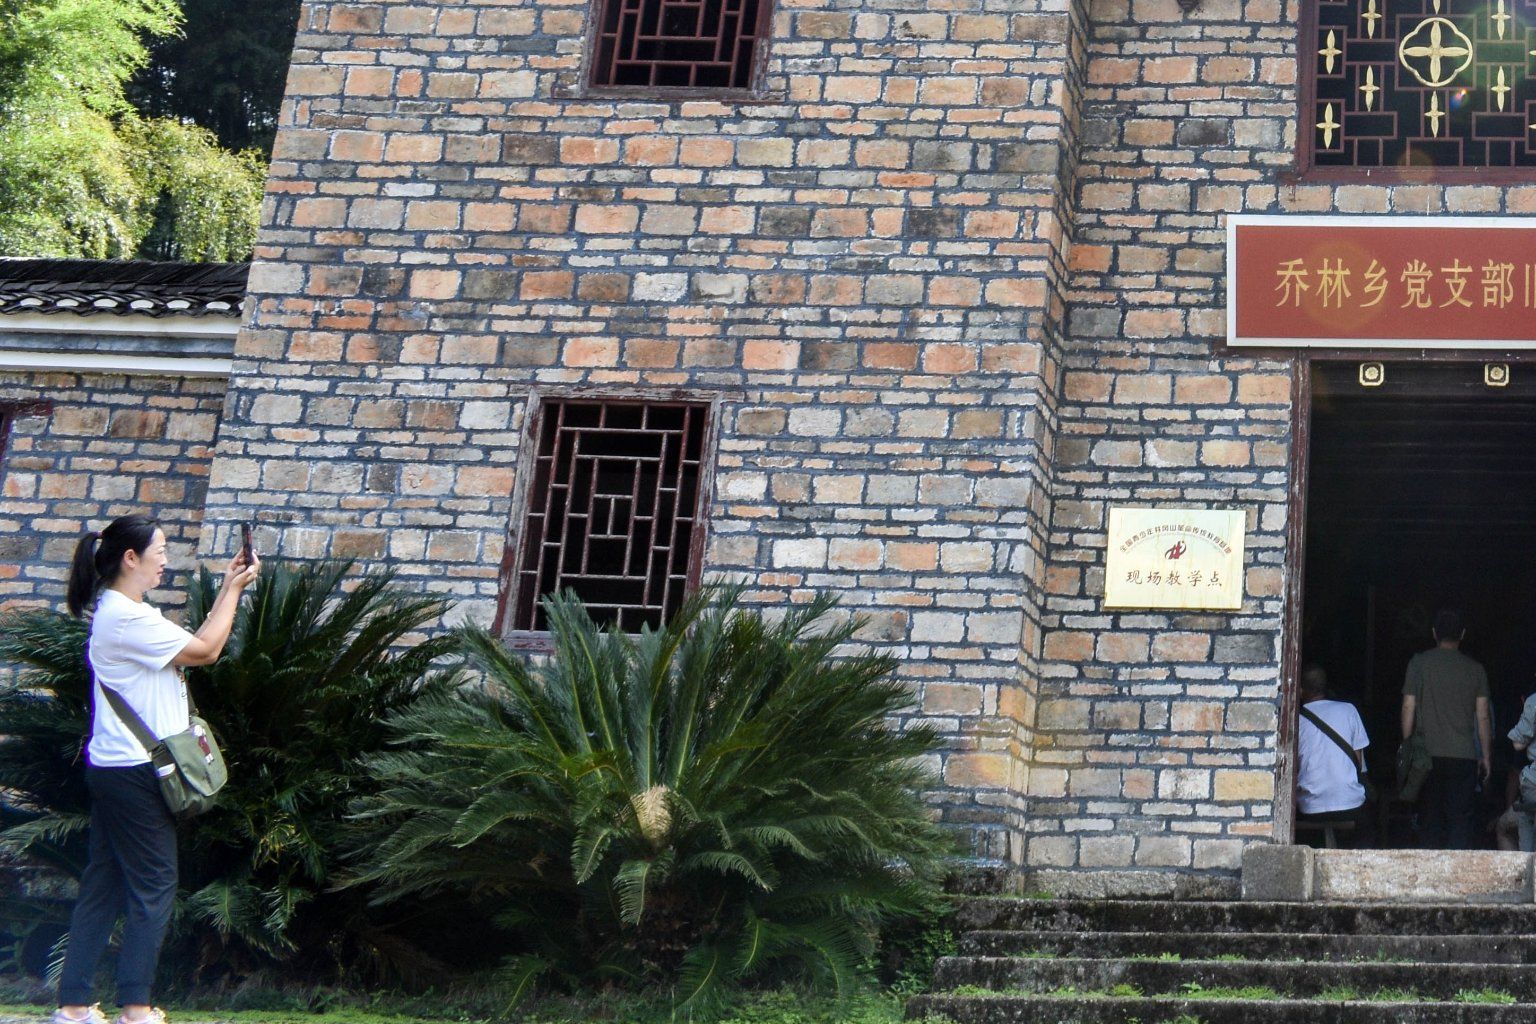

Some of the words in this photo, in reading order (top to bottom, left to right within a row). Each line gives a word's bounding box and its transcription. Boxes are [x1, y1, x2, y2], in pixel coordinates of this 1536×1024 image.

[1126, 570, 1223, 587] 现场教学点
